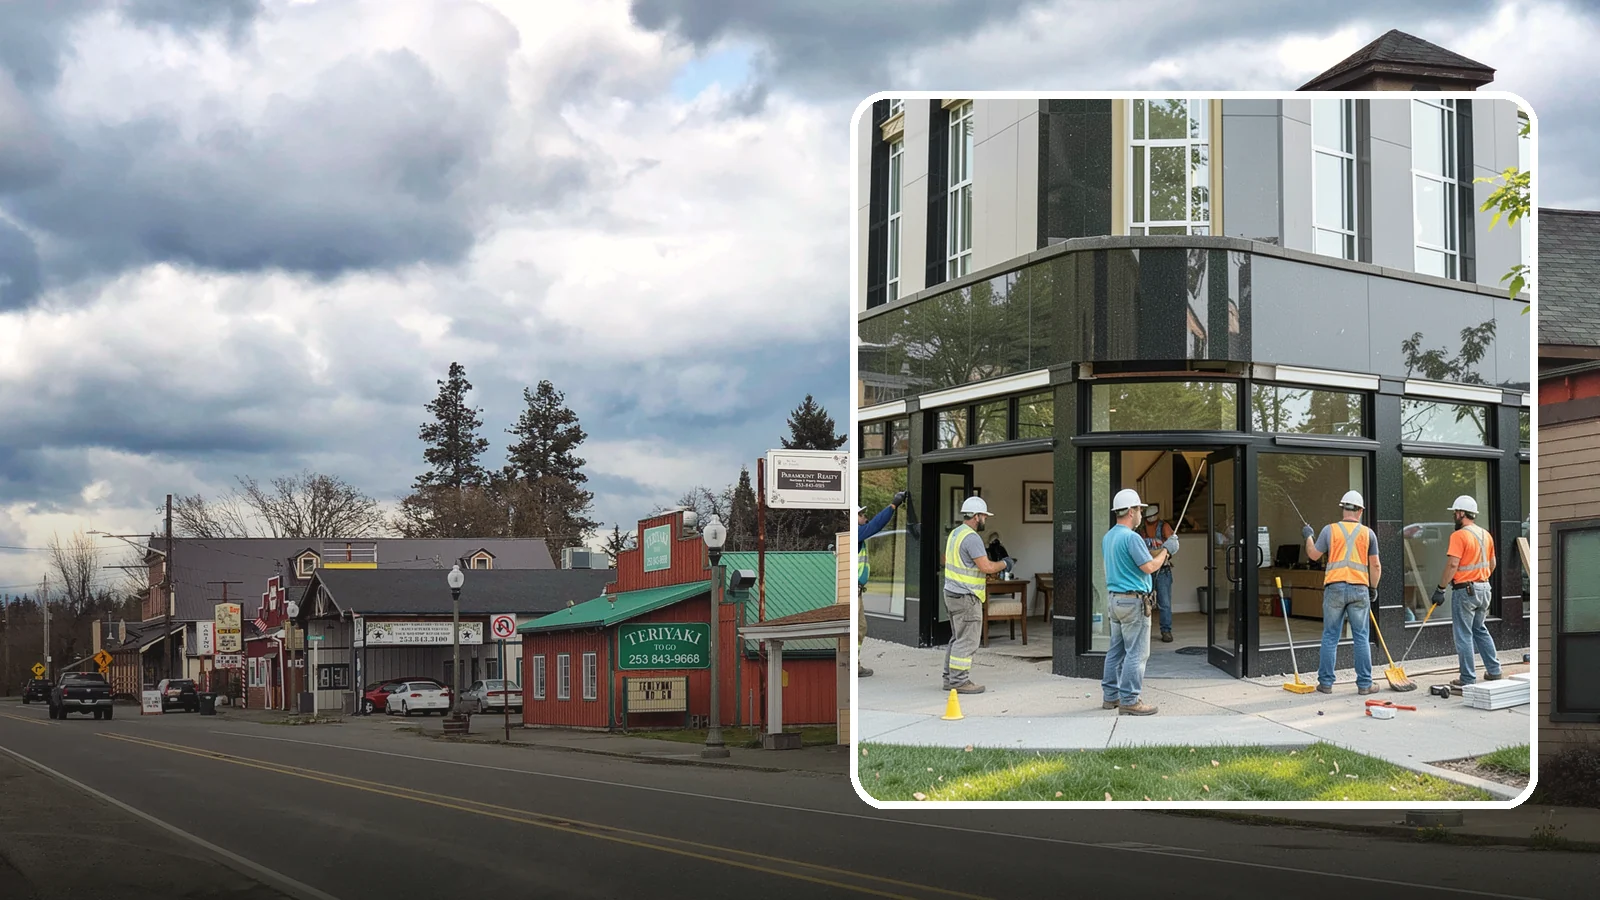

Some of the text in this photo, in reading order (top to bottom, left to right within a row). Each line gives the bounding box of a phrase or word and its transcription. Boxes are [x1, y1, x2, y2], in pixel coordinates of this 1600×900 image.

[625, 627, 702, 646] TERIYAKI
[629, 654, 700, 665] 253 843-9668
